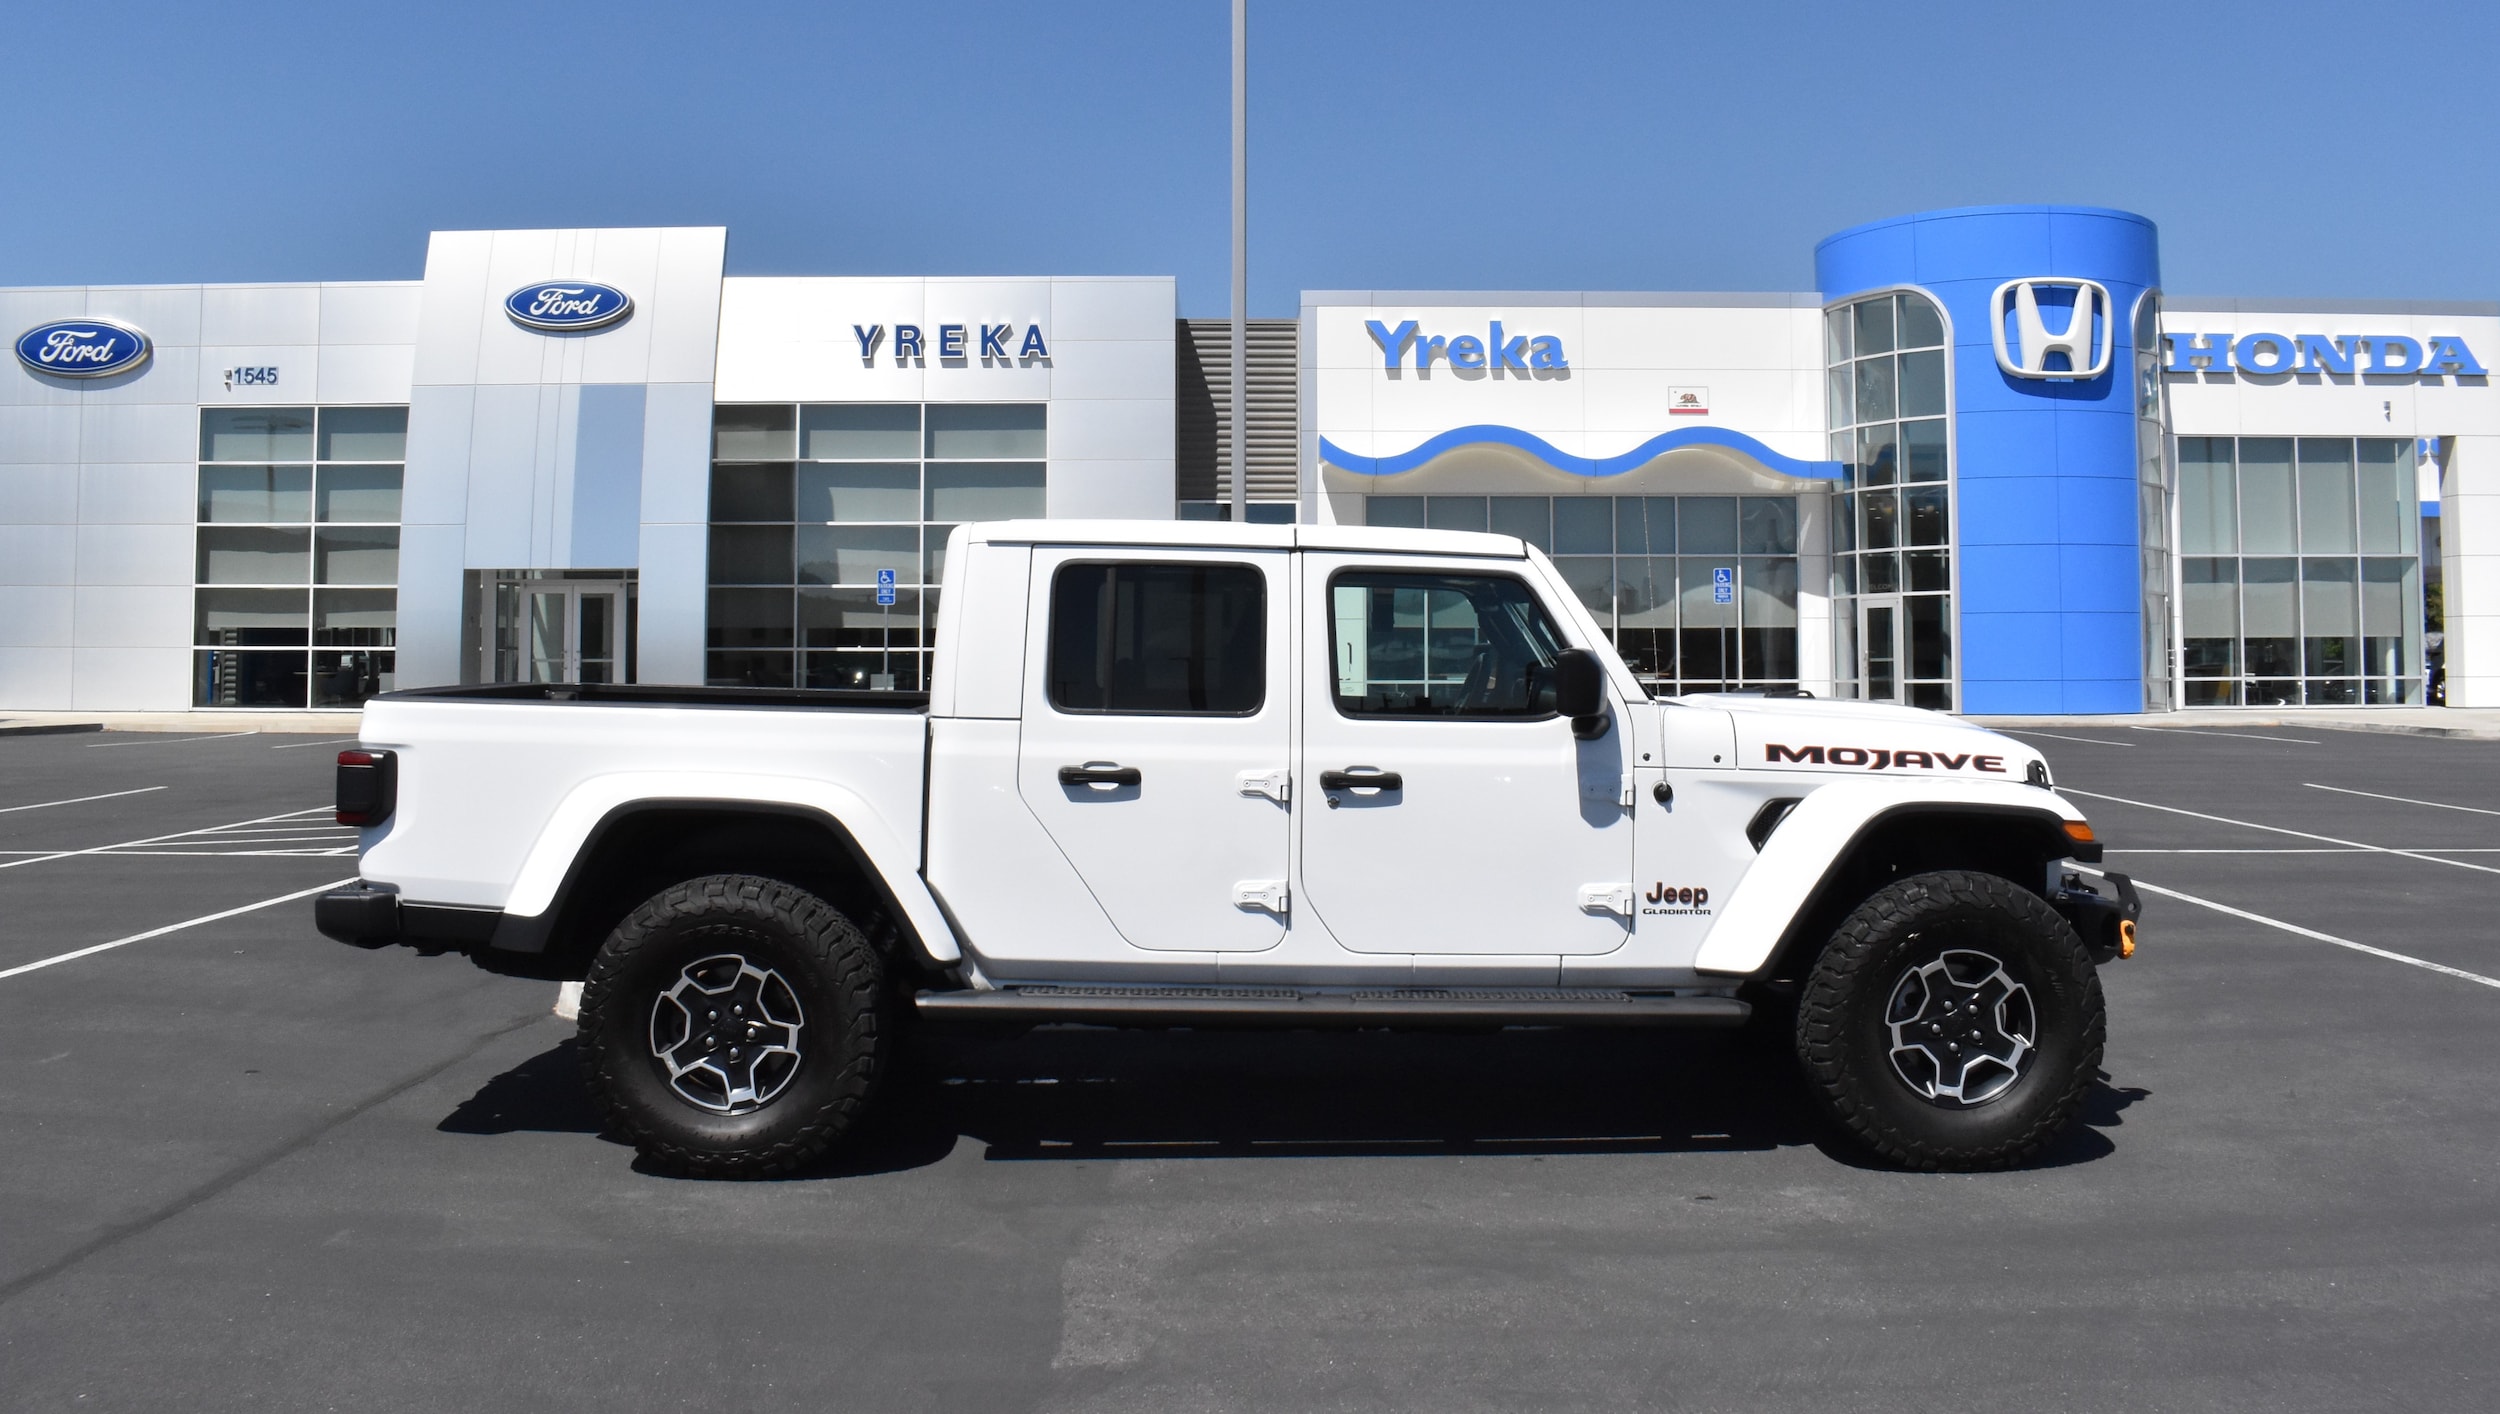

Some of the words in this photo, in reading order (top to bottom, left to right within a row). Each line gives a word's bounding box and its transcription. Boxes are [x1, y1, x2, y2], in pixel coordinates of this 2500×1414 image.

[530, 288, 601, 316] Ford
[39, 330, 116, 363] Ford
[852, 324, 1050, 358] YREKA
[1364, 320, 1569, 369] Yreka
[2162, 333, 2489, 376] HONDA
[234, 367, 278, 384] 1545
[1765, 743, 2007, 773] MOJAVE
[1646, 881, 1709, 908] Jeep
[1643, 908, 1712, 916] GLADIATOR
